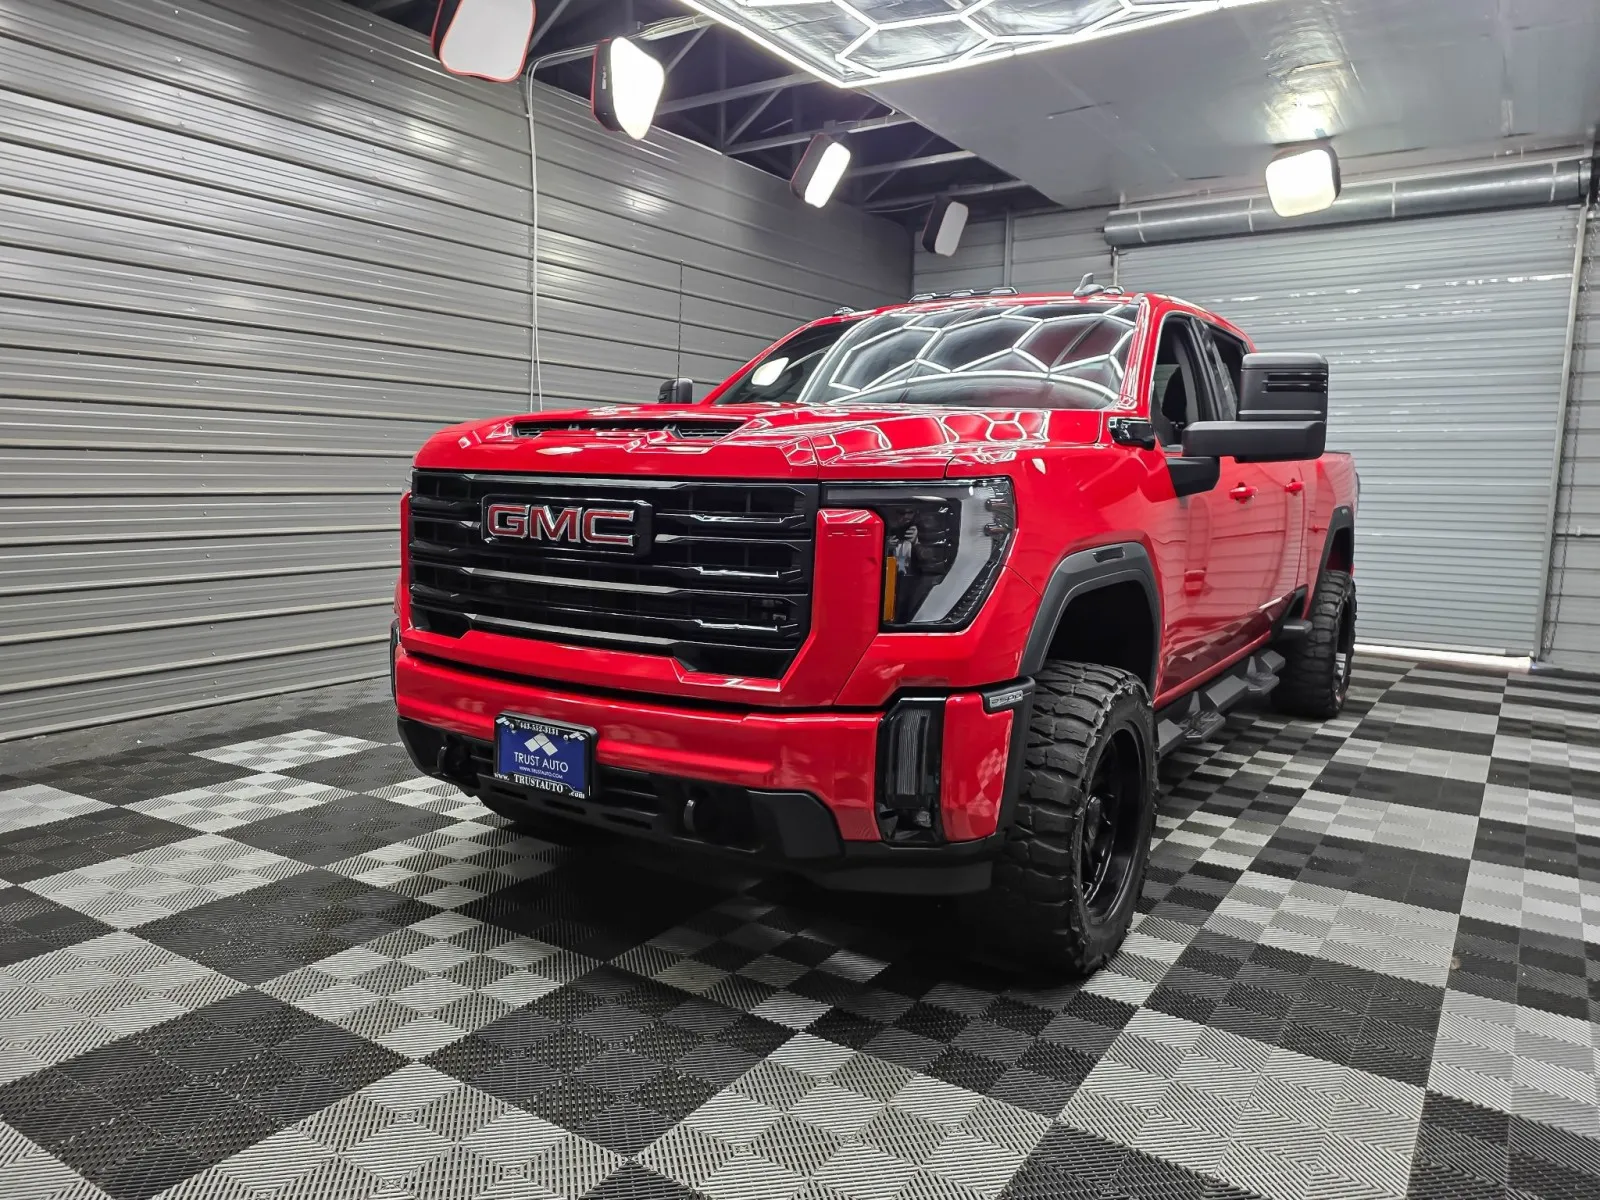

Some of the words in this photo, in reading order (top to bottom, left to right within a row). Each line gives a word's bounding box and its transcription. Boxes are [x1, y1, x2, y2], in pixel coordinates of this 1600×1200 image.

[487, 504, 635, 547] GMC
[514, 752, 540, 767] TRUST
[542, 759, 569, 773] AUTO
[519, 766, 563, 780] WWW.TRUSTAUTO.COM
[513, 774, 564, 793] TRUSTAUTO
